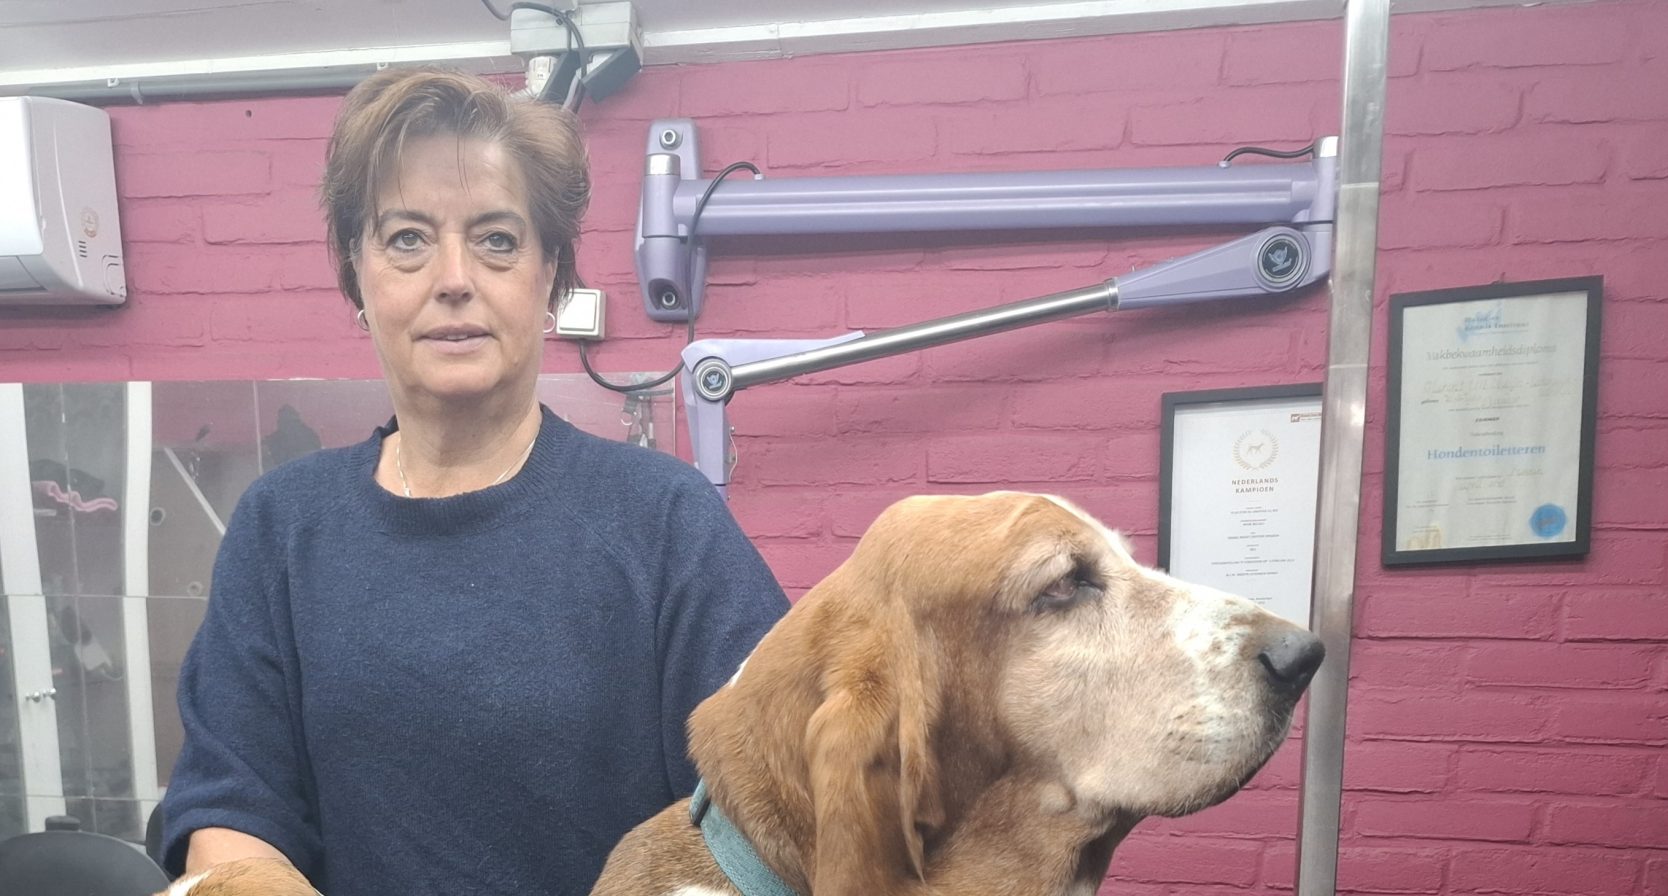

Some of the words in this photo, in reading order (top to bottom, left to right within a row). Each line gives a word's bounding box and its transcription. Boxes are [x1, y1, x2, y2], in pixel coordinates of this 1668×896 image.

[1427, 444, 1546, 460] Hondentoiletteren
[1231, 477, 1279, 486] NEDERLANDS
[1235, 486, 1275, 494] KAMPIOEN
